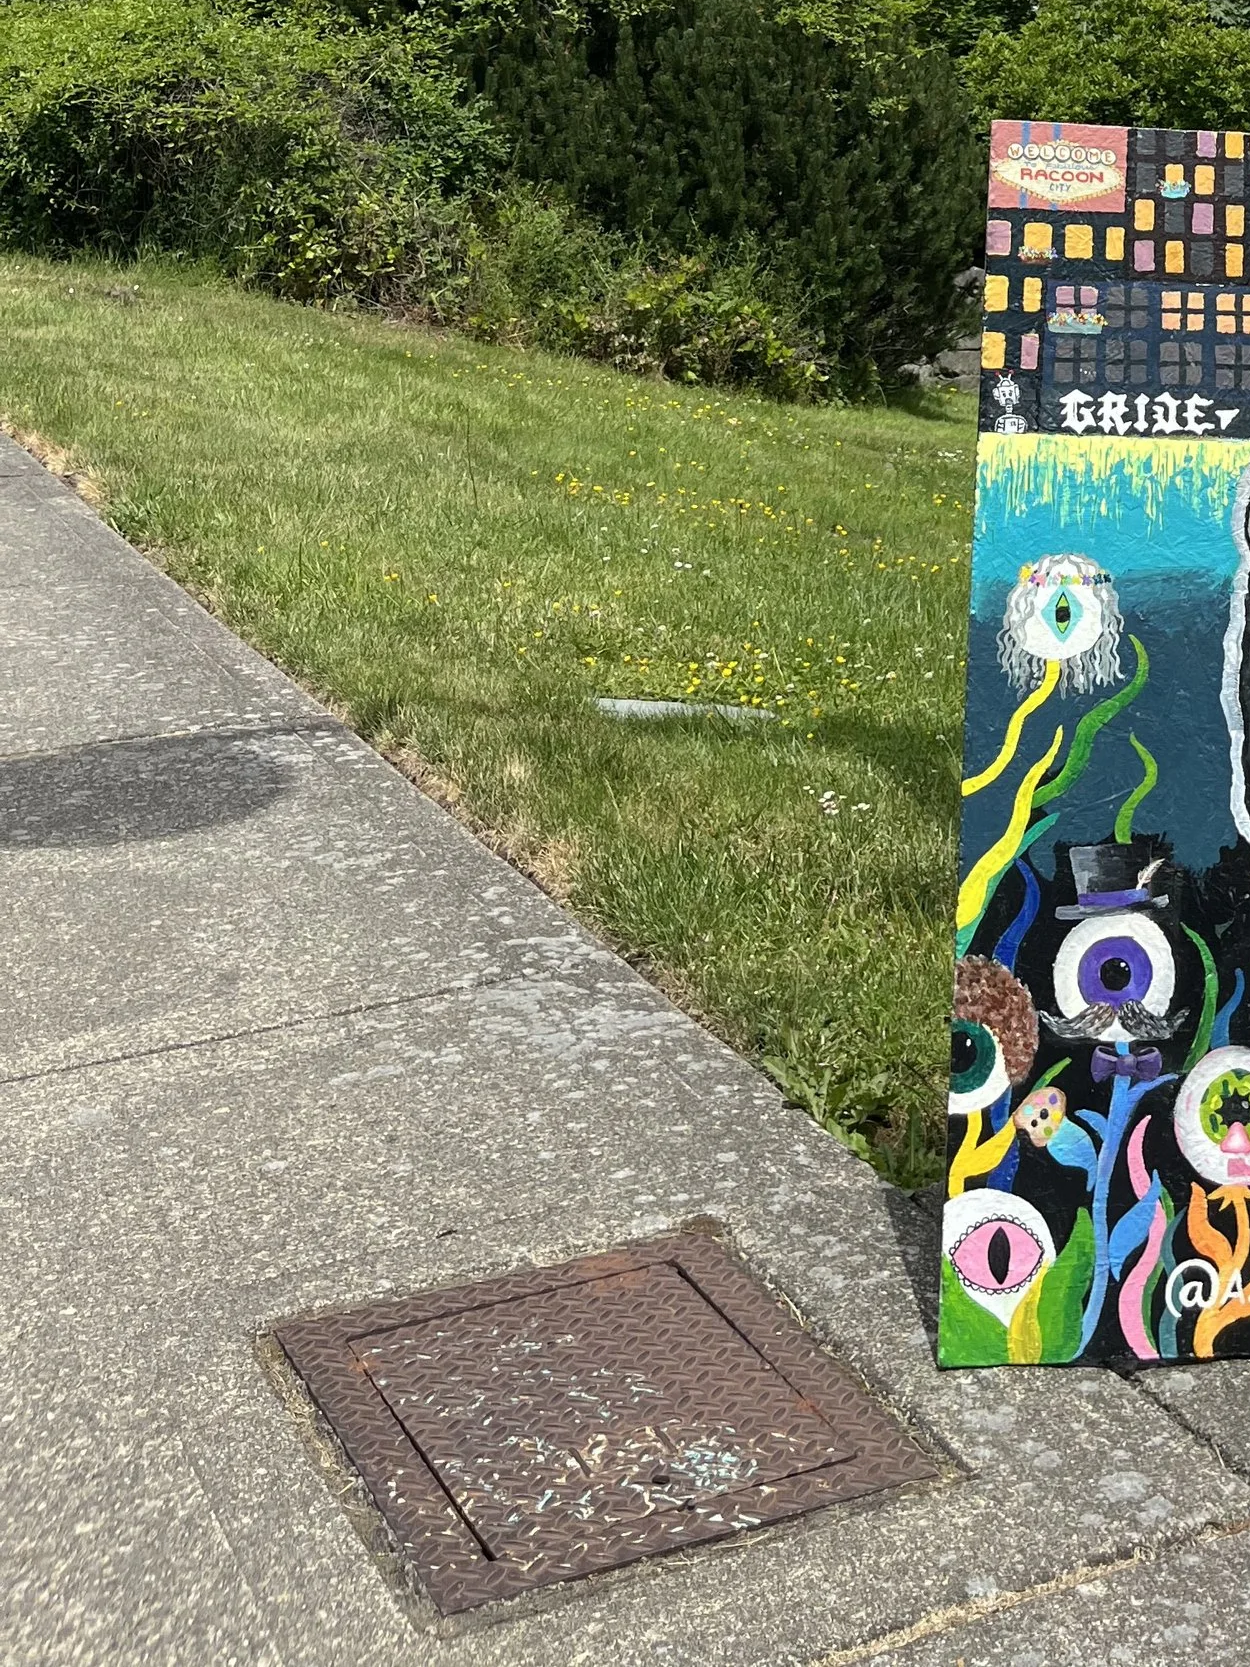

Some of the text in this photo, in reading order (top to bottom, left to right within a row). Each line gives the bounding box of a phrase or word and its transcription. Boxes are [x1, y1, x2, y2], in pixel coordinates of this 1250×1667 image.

[1009, 144, 1114, 165] WELCOME
[1020, 167, 1104, 183] RACOON
[1049, 182, 1072, 192] CITY
